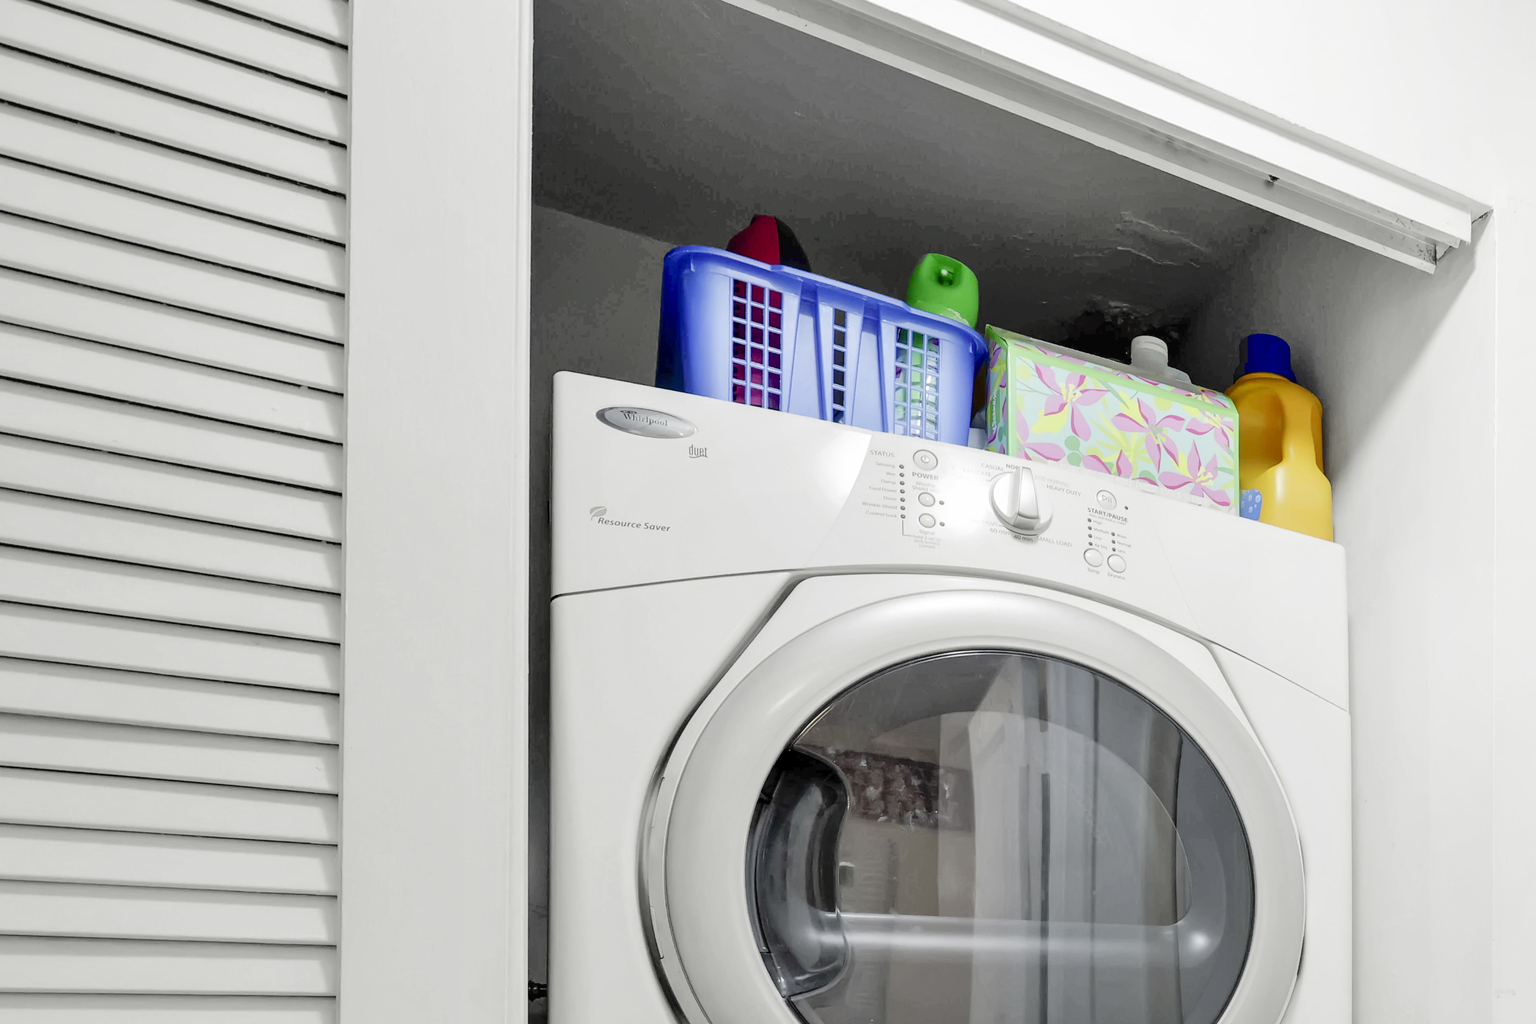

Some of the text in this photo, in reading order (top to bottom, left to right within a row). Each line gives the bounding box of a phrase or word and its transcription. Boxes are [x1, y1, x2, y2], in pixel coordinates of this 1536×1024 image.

[624, 412, 668, 427] Whirlpool
[688, 444, 708, 459] duet
[912, 471, 939, 481] POWER
[1046, 484, 1081, 497] HEAVY DUTY
[1087, 507, 1128, 523] START/PAUSE
[598, 517, 671, 532] Resource Saver
